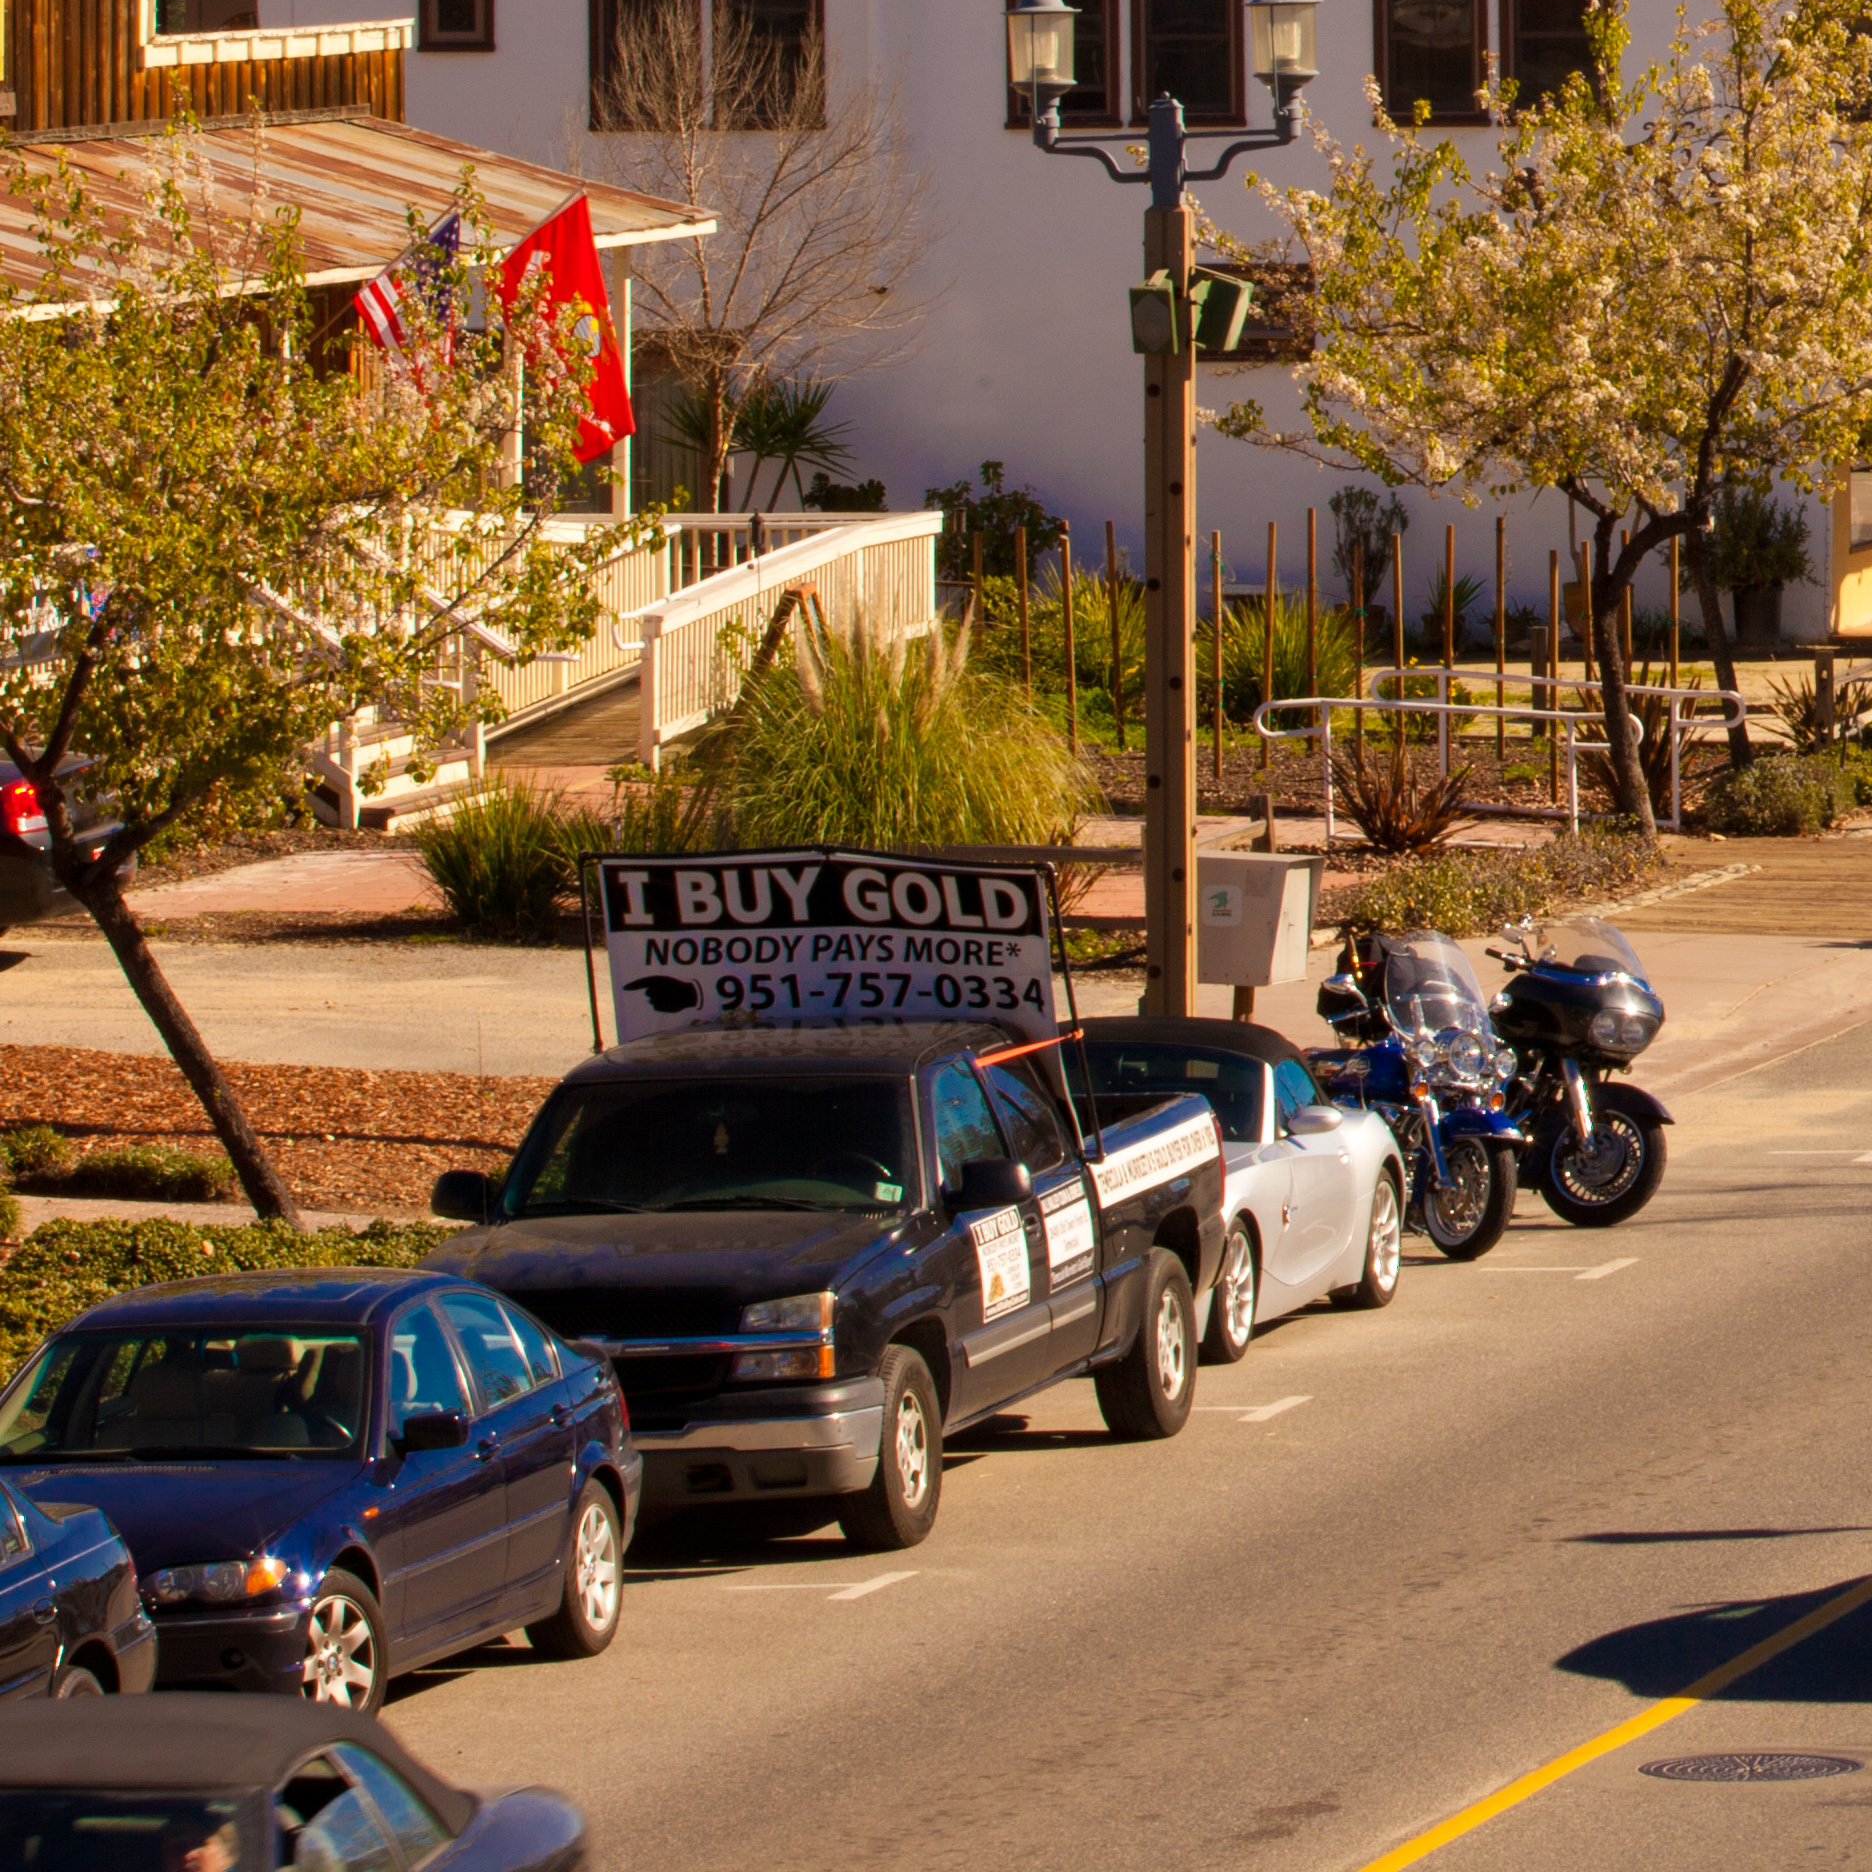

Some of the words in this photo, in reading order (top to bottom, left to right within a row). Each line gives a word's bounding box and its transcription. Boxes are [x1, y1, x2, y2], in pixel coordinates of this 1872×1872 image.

[618, 870, 655, 925] I
[674, 867, 822, 925] BUY
[842, 868, 1029, 929] GOLD
[645, 934, 804, 966] NOBODY
[811, 933, 895, 963] PAYS
[715, 971, 1045, 1014] 951-757-0334
[981, 1217, 998, 1244] BUY
[997, 1208, 1019, 1236] GOLD
